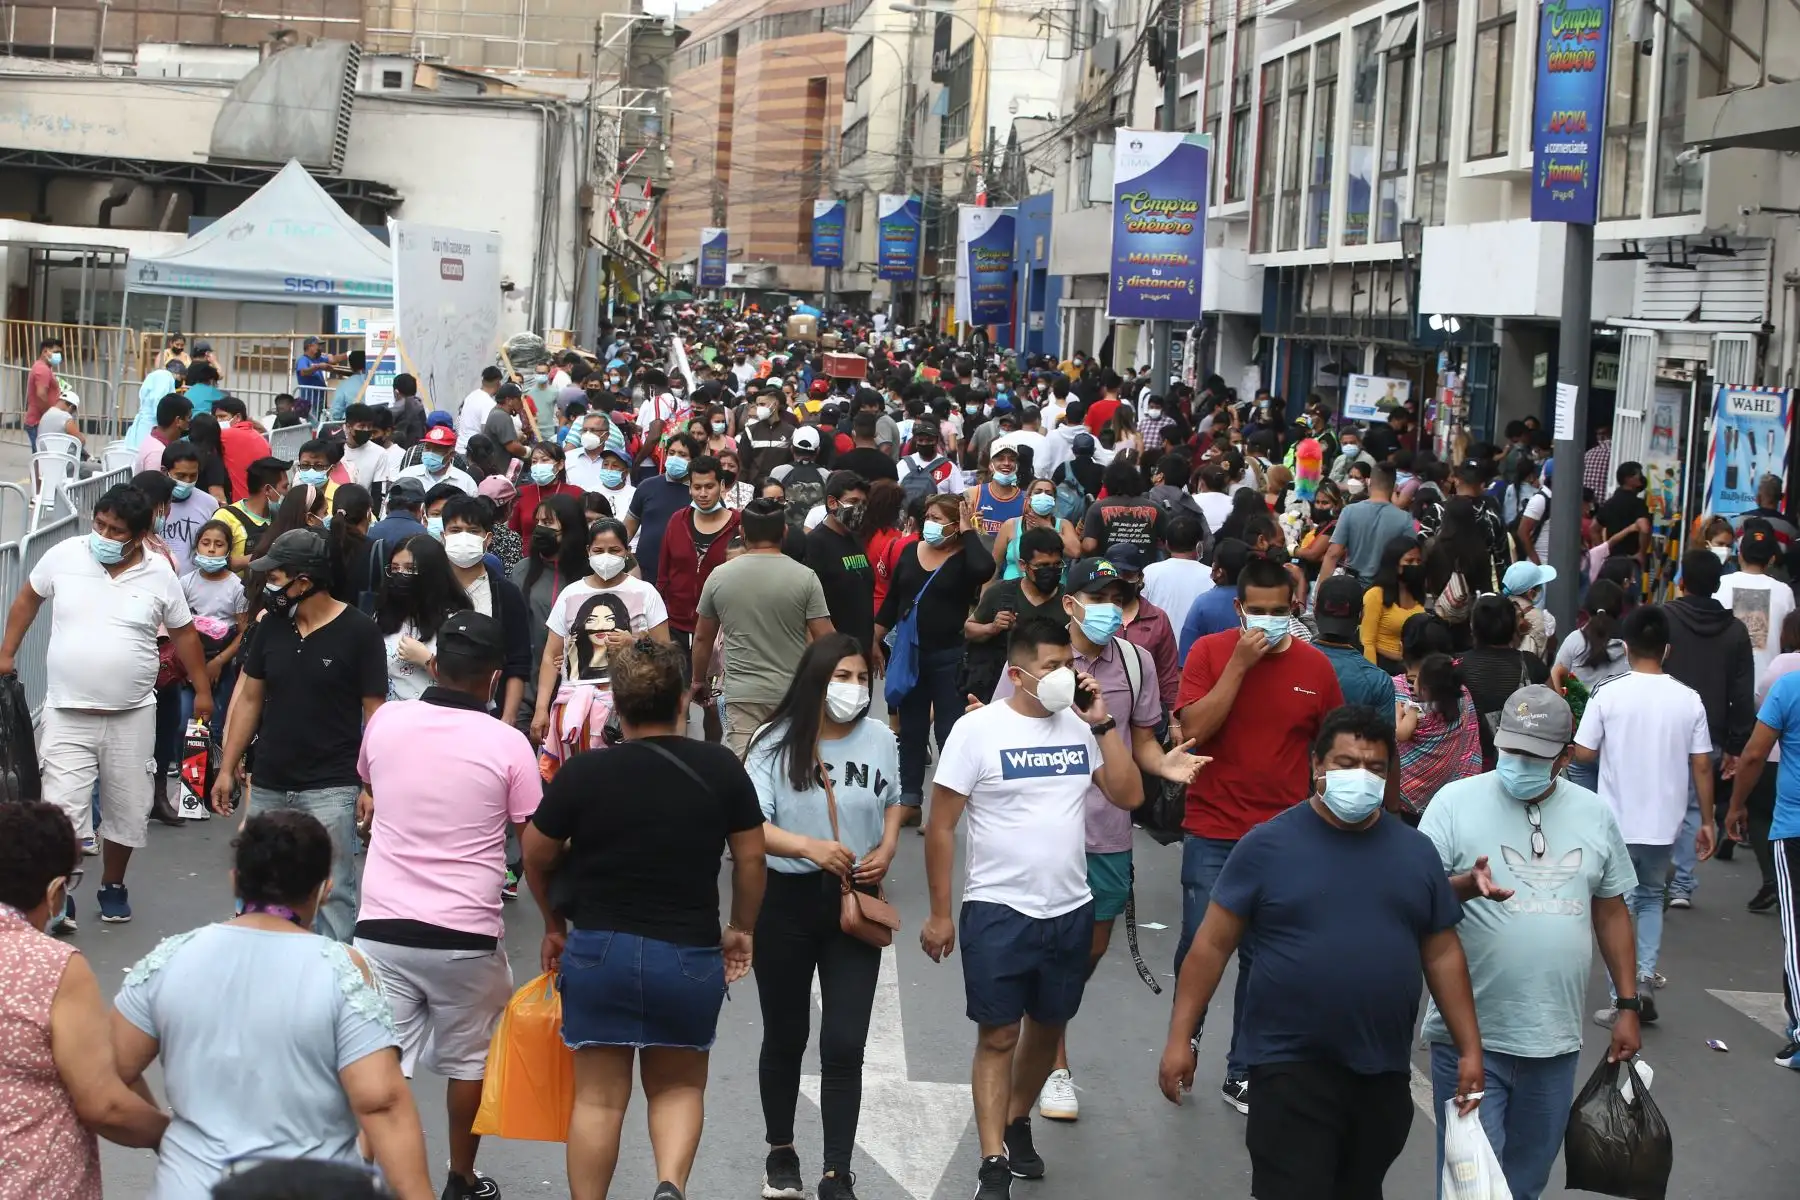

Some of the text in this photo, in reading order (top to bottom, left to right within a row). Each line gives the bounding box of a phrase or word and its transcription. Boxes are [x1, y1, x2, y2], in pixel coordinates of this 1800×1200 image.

[1546, 0, 1602, 40] Compra
[1548, 111, 1587, 133] APOYA
[1545, 159, 1584, 188] formal
[1120, 191, 1199, 217] Compra
[1127, 218, 1193, 235] chévere
[1128, 251, 1189, 267] MANTÉN
[1151, 268, 1162, 276] tu
[284, 277, 339, 293] SISOL
[1126, 275, 1187, 289] distancia
[1732, 397, 1774, 412] WAHL
[1005, 748, 1084, 774] Wrangler
